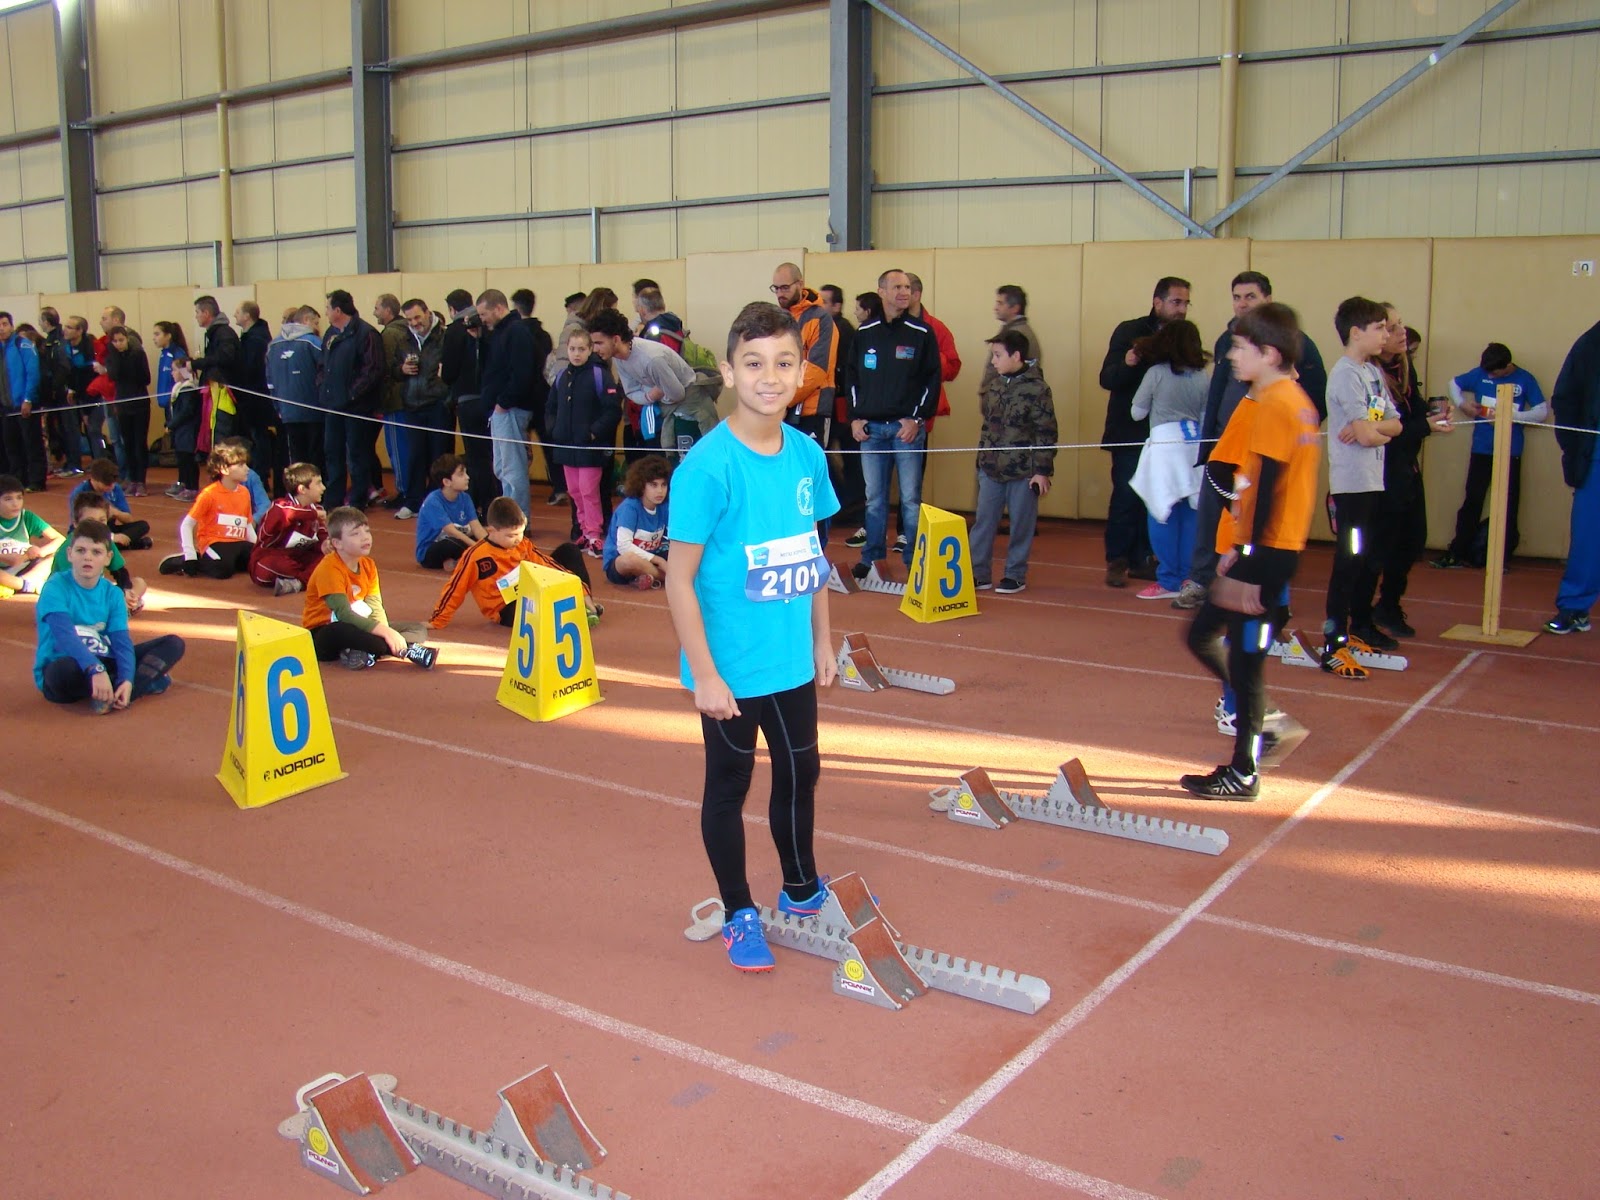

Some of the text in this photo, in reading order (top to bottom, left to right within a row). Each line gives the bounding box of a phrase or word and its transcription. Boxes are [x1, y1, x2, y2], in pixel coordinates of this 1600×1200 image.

[226, 526, 245, 538] 2271
[761, 562, 820, 597] 2101
[914, 533, 926, 595] 3
[938, 536, 962, 598] 3
[938, 601, 969, 613] NORDIC
[517, 596, 535, 679] 5
[553, 596, 582, 679] 5
[236, 650, 245, 748] 6
[267, 656, 311, 756] 6
[513, 681, 537, 697] NORDIC
[559, 678, 593, 698] NORDIC
[274, 753, 326, 779] NORDIC
